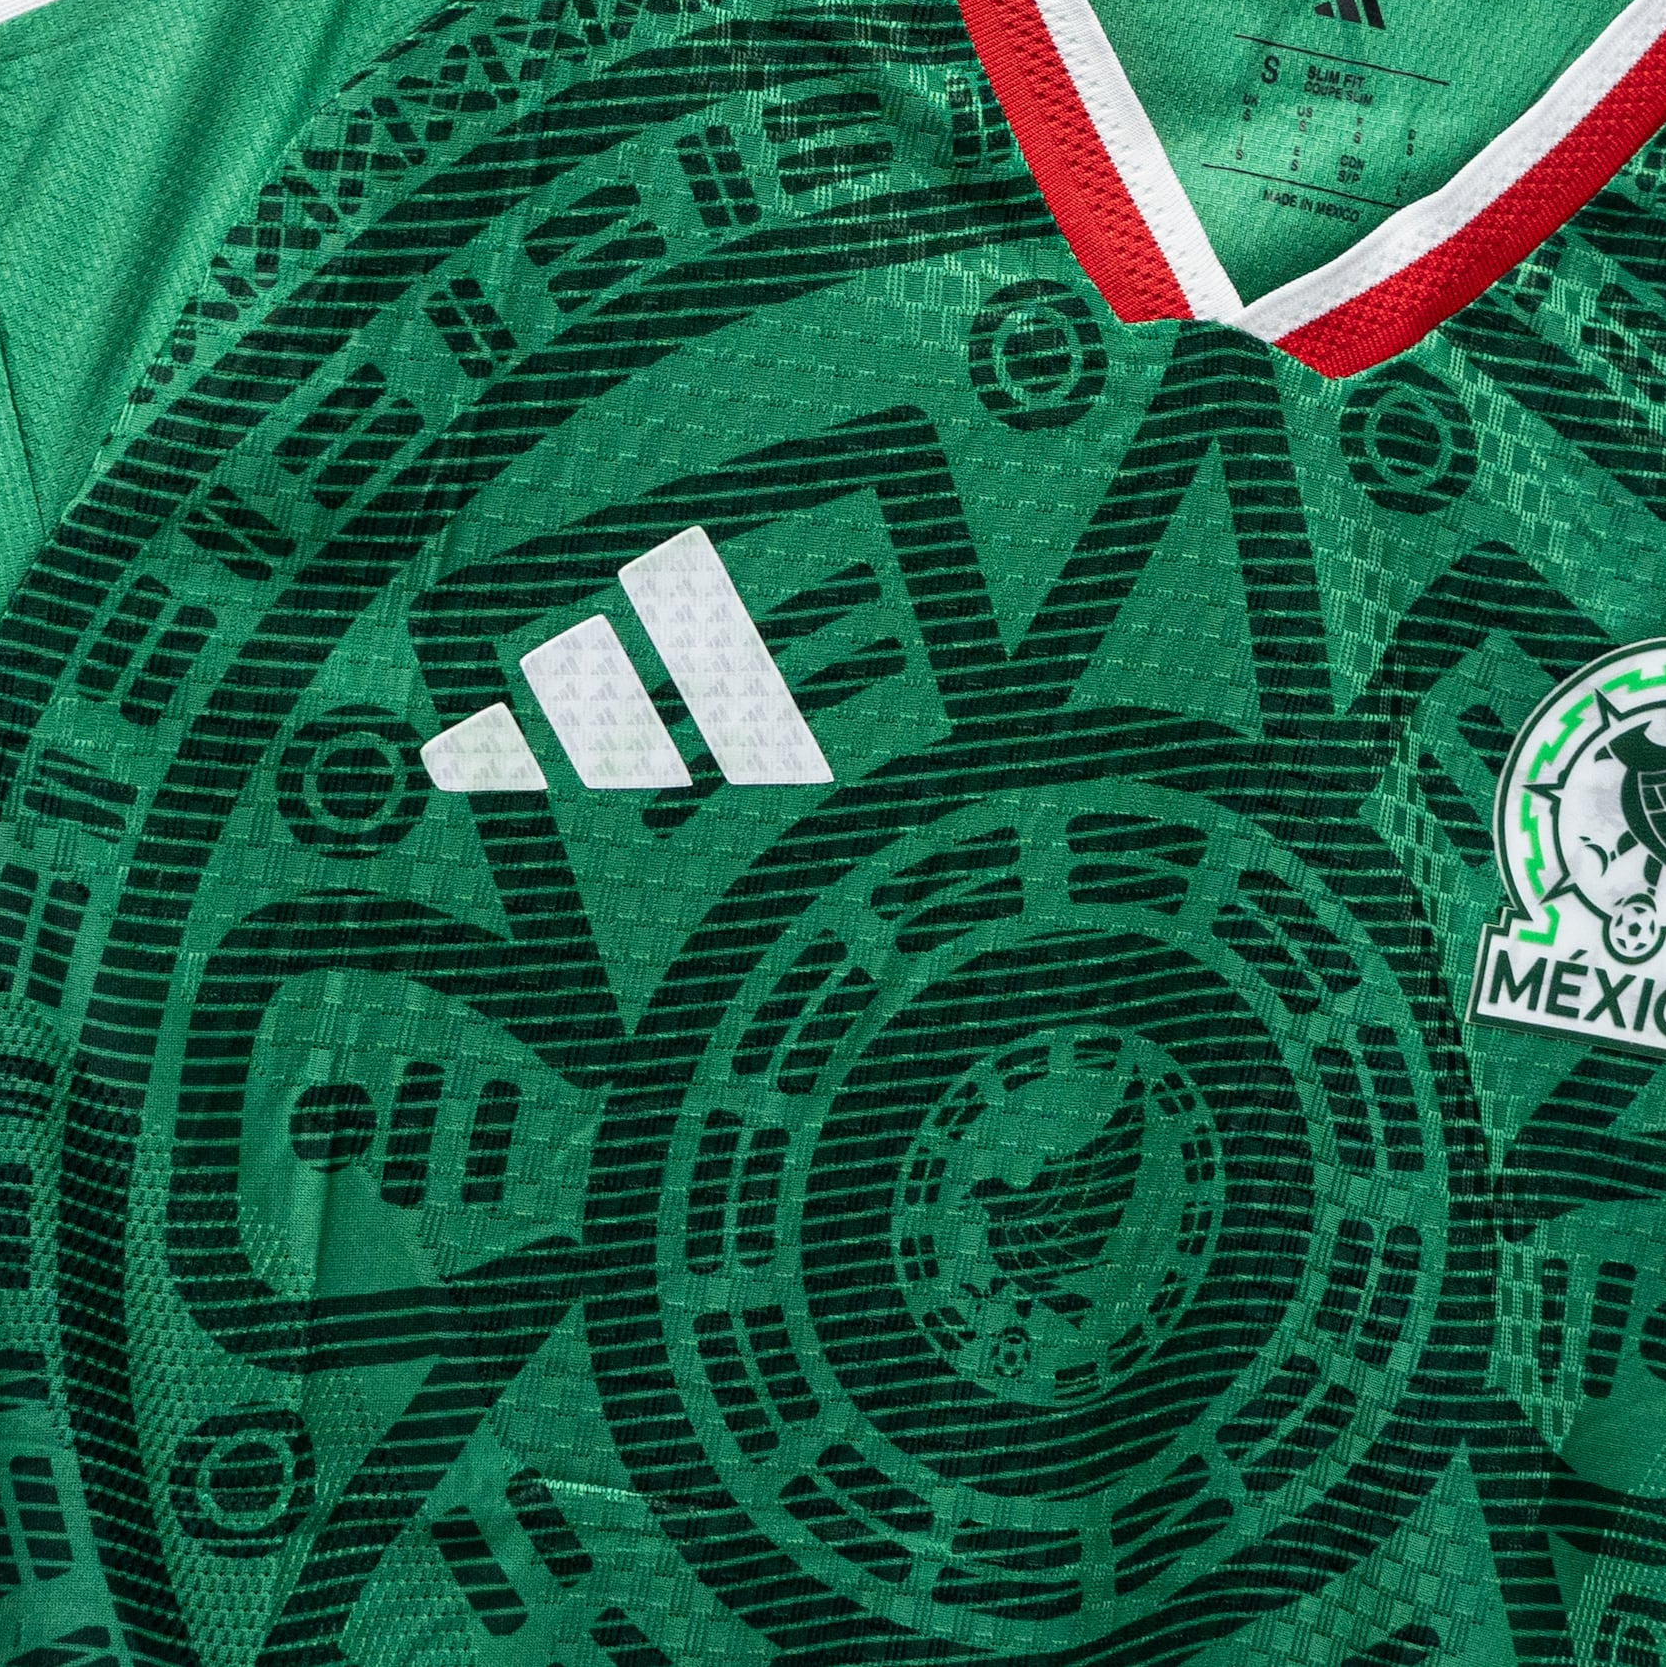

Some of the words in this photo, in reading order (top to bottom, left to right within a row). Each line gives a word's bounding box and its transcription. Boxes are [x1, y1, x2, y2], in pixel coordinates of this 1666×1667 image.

[1260, 54, 1280, 85] S
[1306, 65, 1341, 85] SLIM
[1343, 73, 1365, 89] FIT
[1296, 105, 1314, 118] US
[1406, 143, 1414, 156] S
[1263, 189, 1298, 208] MADE
[1299, 197, 1314, 212] IN
